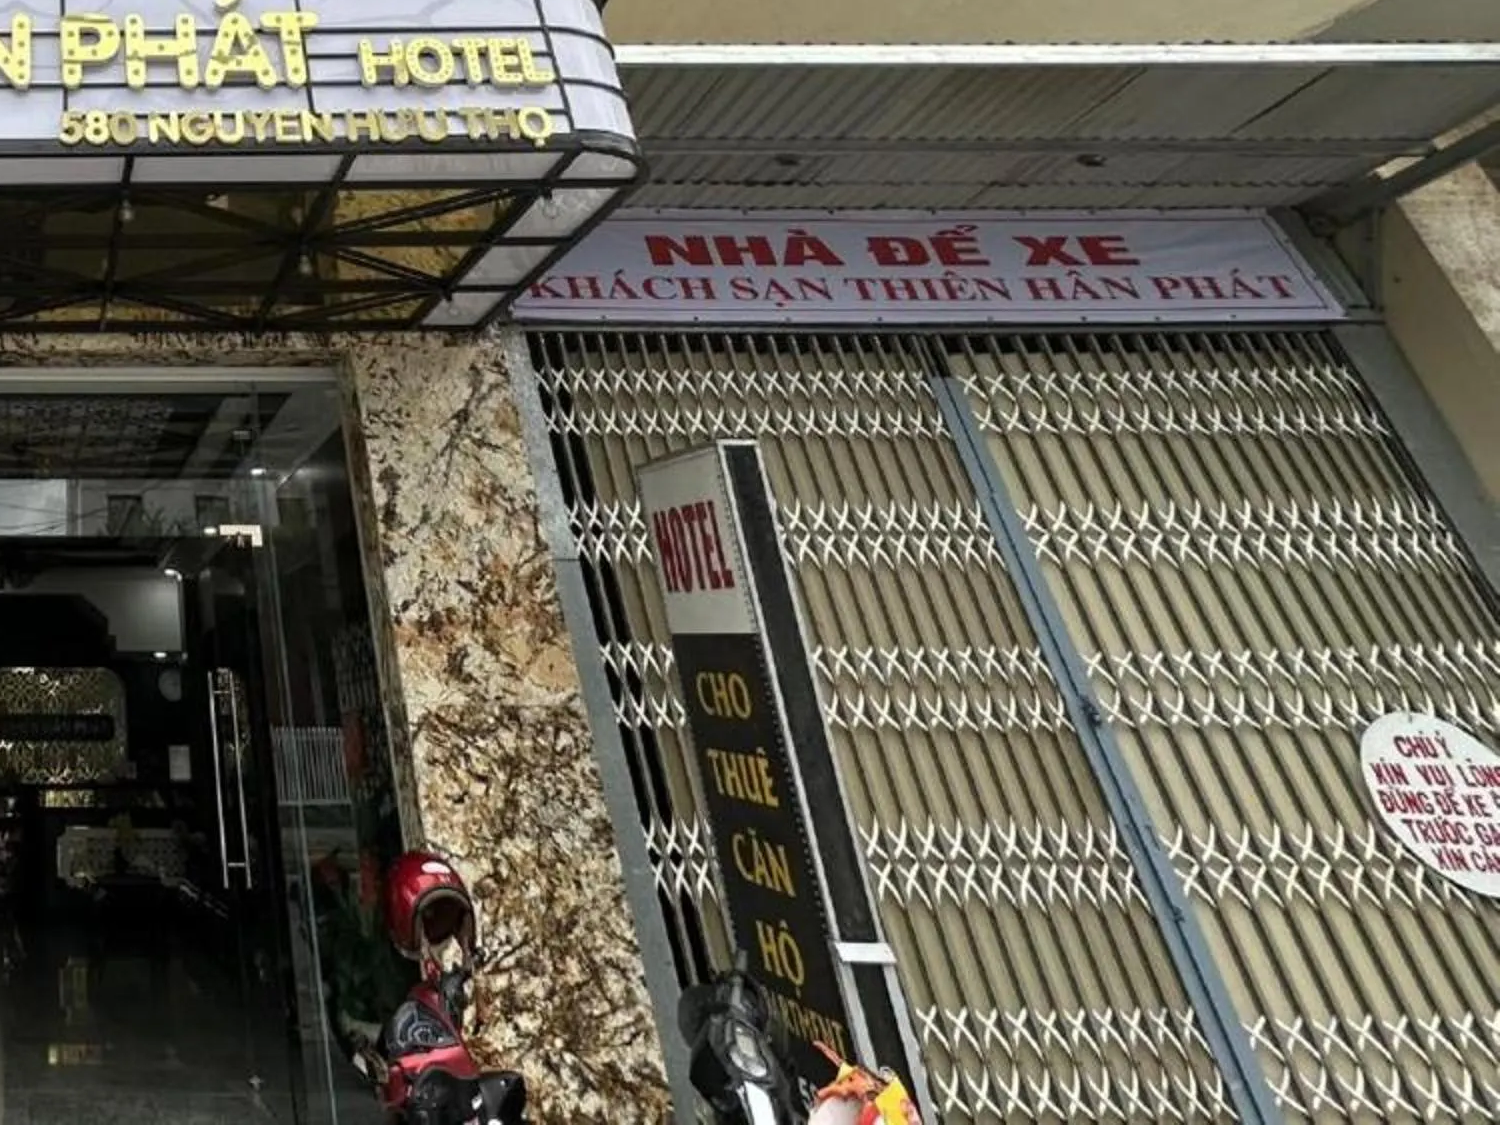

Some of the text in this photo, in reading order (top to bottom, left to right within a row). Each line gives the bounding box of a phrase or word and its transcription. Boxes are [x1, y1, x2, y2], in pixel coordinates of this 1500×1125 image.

[356, 35, 557, 89] HOTEL
[59, 109, 137, 145] 580
[457, 106, 553, 148] THỌ
[644, 224, 1141, 267] NHÀ ĐỂ XE
[528, 268, 1297, 307] KHÁCH SẠN THIÊN HÂN PHÁT
[653, 499, 736, 593] HOTEL
[696, 671, 752, 720] CHO
[706, 746, 779, 808] THUÊ
[1414, 764, 1455, 786] VUI
